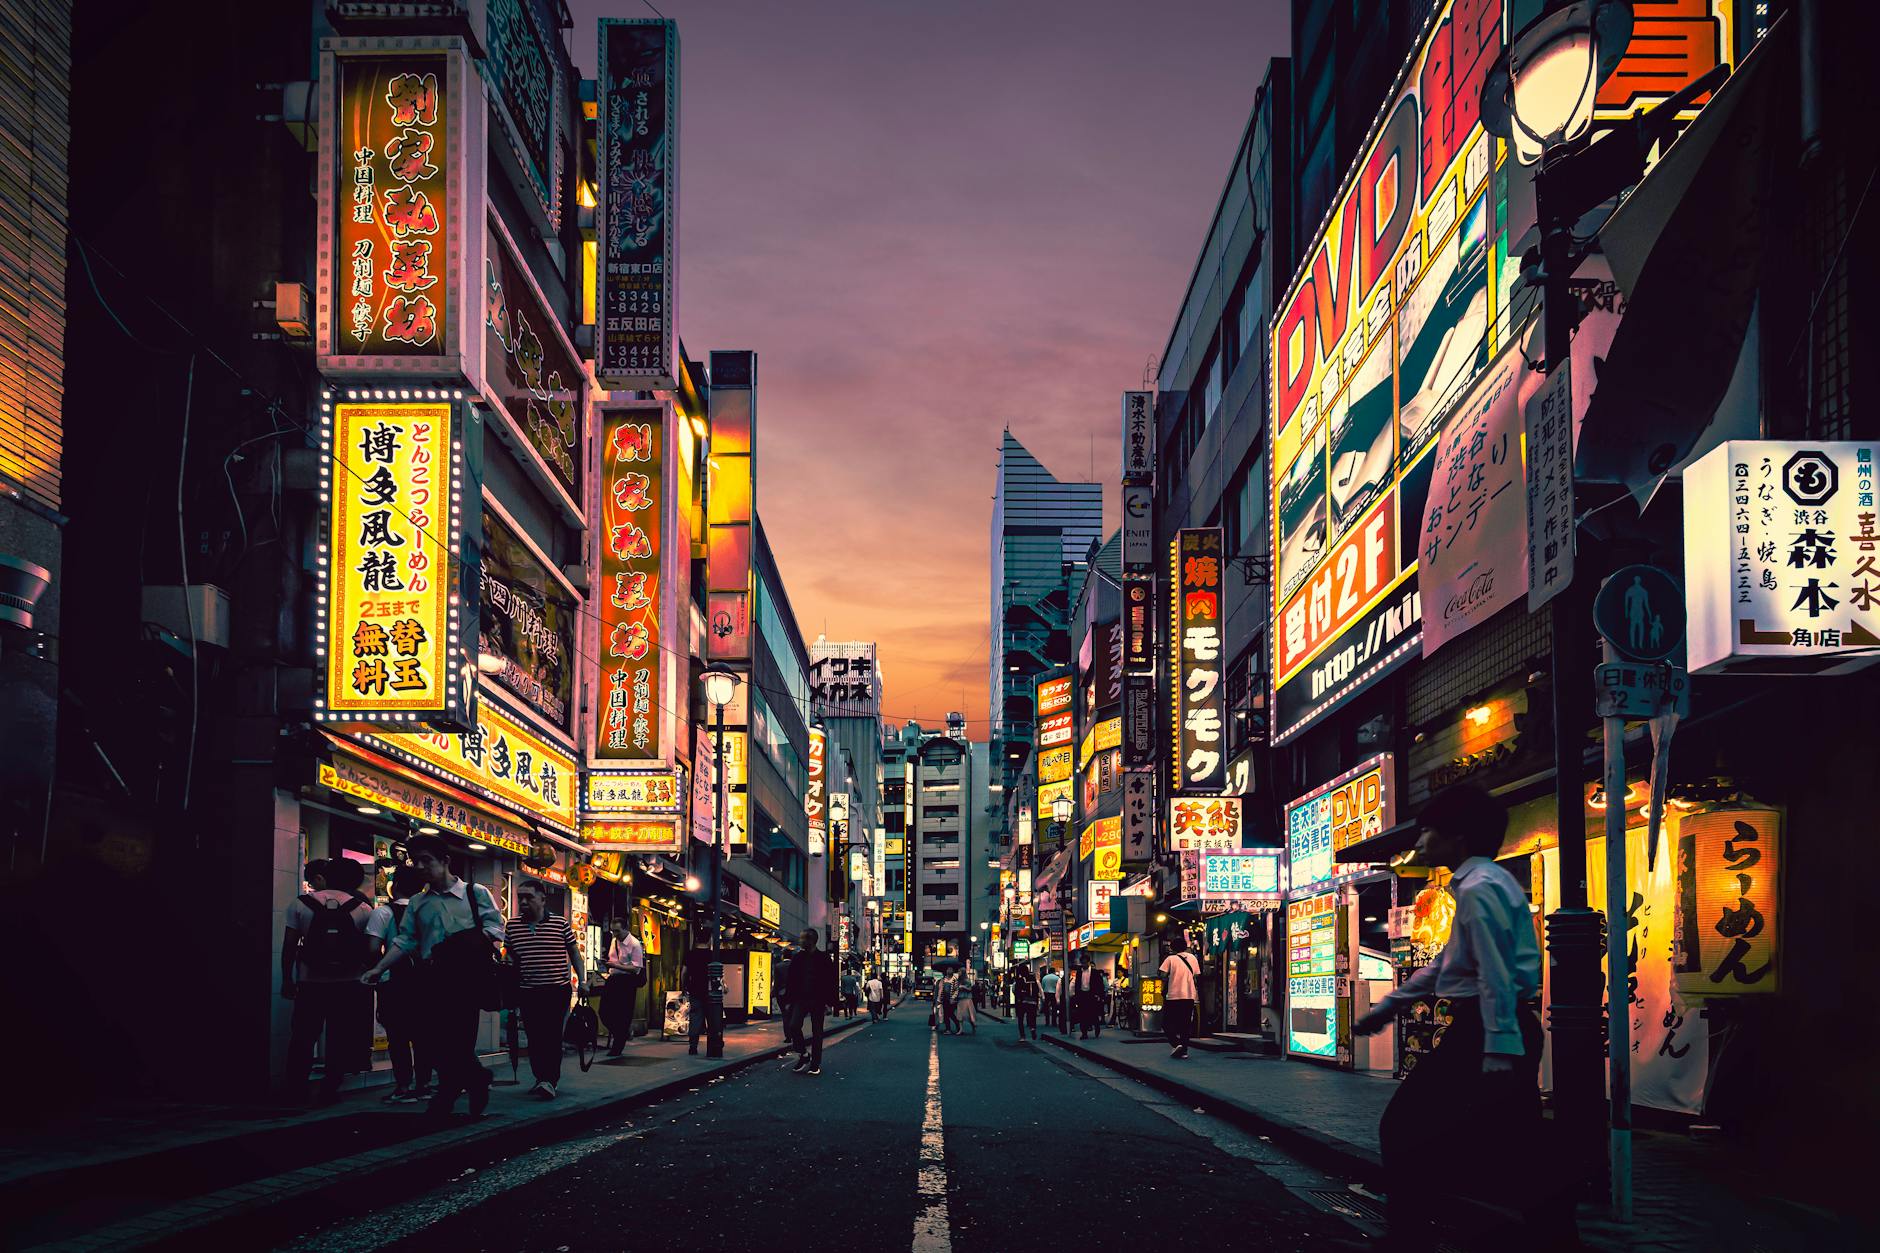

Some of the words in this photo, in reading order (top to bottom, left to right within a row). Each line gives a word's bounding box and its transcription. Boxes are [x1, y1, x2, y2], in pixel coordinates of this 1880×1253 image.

[353, 147, 375, 223] 中国料理
[608, 263, 663, 274] 新宿東口店
[618, 290, 660, 301] 3341
[606, 317, 662, 331] 五反田店
[618, 345, 661, 356] 3444
[1448, 422, 1487, 484] 渋谷
[1426, 432, 1508, 534] おとなり
[1541, 392, 1558, 586] 防犯カメラ作動中
[1856, 447, 1874, 507] 信州の酒
[358, 422, 405, 592] 博多風龍
[408, 422, 430, 592] とんこつらーめん
[1424, 480, 1513, 565] サンデー
[1757, 457, 1778, 591] うなぎ・焼鳥
[1793, 509, 1829, 526] 渋谷
[1786, 528, 1840, 618] 森本
[1849, 511, 1880, 611] 喜久水
[1184, 556, 1218, 621] 焼肉
[1284, 510, 1386, 665] 受付2F
[360, 599, 421, 618] 2玉まで
[1131, 632, 1145, 654] One
[1791, 628, 1841, 648] 角店
[352, 621, 389, 695] 無料
[390, 620, 426, 691] 替玉
[810, 656, 872, 677] イワキ
[810, 682, 873, 700] メガネ
[1040, 699, 1053, 711] BIG
[1053, 694, 1072, 706] ECHO
[1041, 681, 1072, 697] カラオケ
[1183, 626, 1222, 783] モクモク
[609, 669, 628, 749] 中国料理
[1041, 715, 1072, 731] カラオケ
[458, 725, 561, 807] 博多風龍
[808, 738, 824, 816] カラオケ
[592, 788, 643, 801] 博多風龍
[645, 780, 669, 791] 替玉
[646, 791, 671, 803] 無料
[1332, 773, 1381, 828] DVD
[1128, 777, 1149, 846] ボルドオ
[1291, 801, 1319, 834] 金太郎
[1193, 839, 1233, 849] 道玄坂店
[1291, 823, 1330, 859] 渋谷書店
[1208, 858, 1241, 872] 金太郎
[1208, 874, 1252, 890] 渋谷書店
[1095, 885, 1111, 916] 中華
[1709, 820, 1773, 985] らーめん
[1142, 980, 1155, 1004] 焼肉
[1290, 977, 1335, 995] 金太郎渋谷書店
